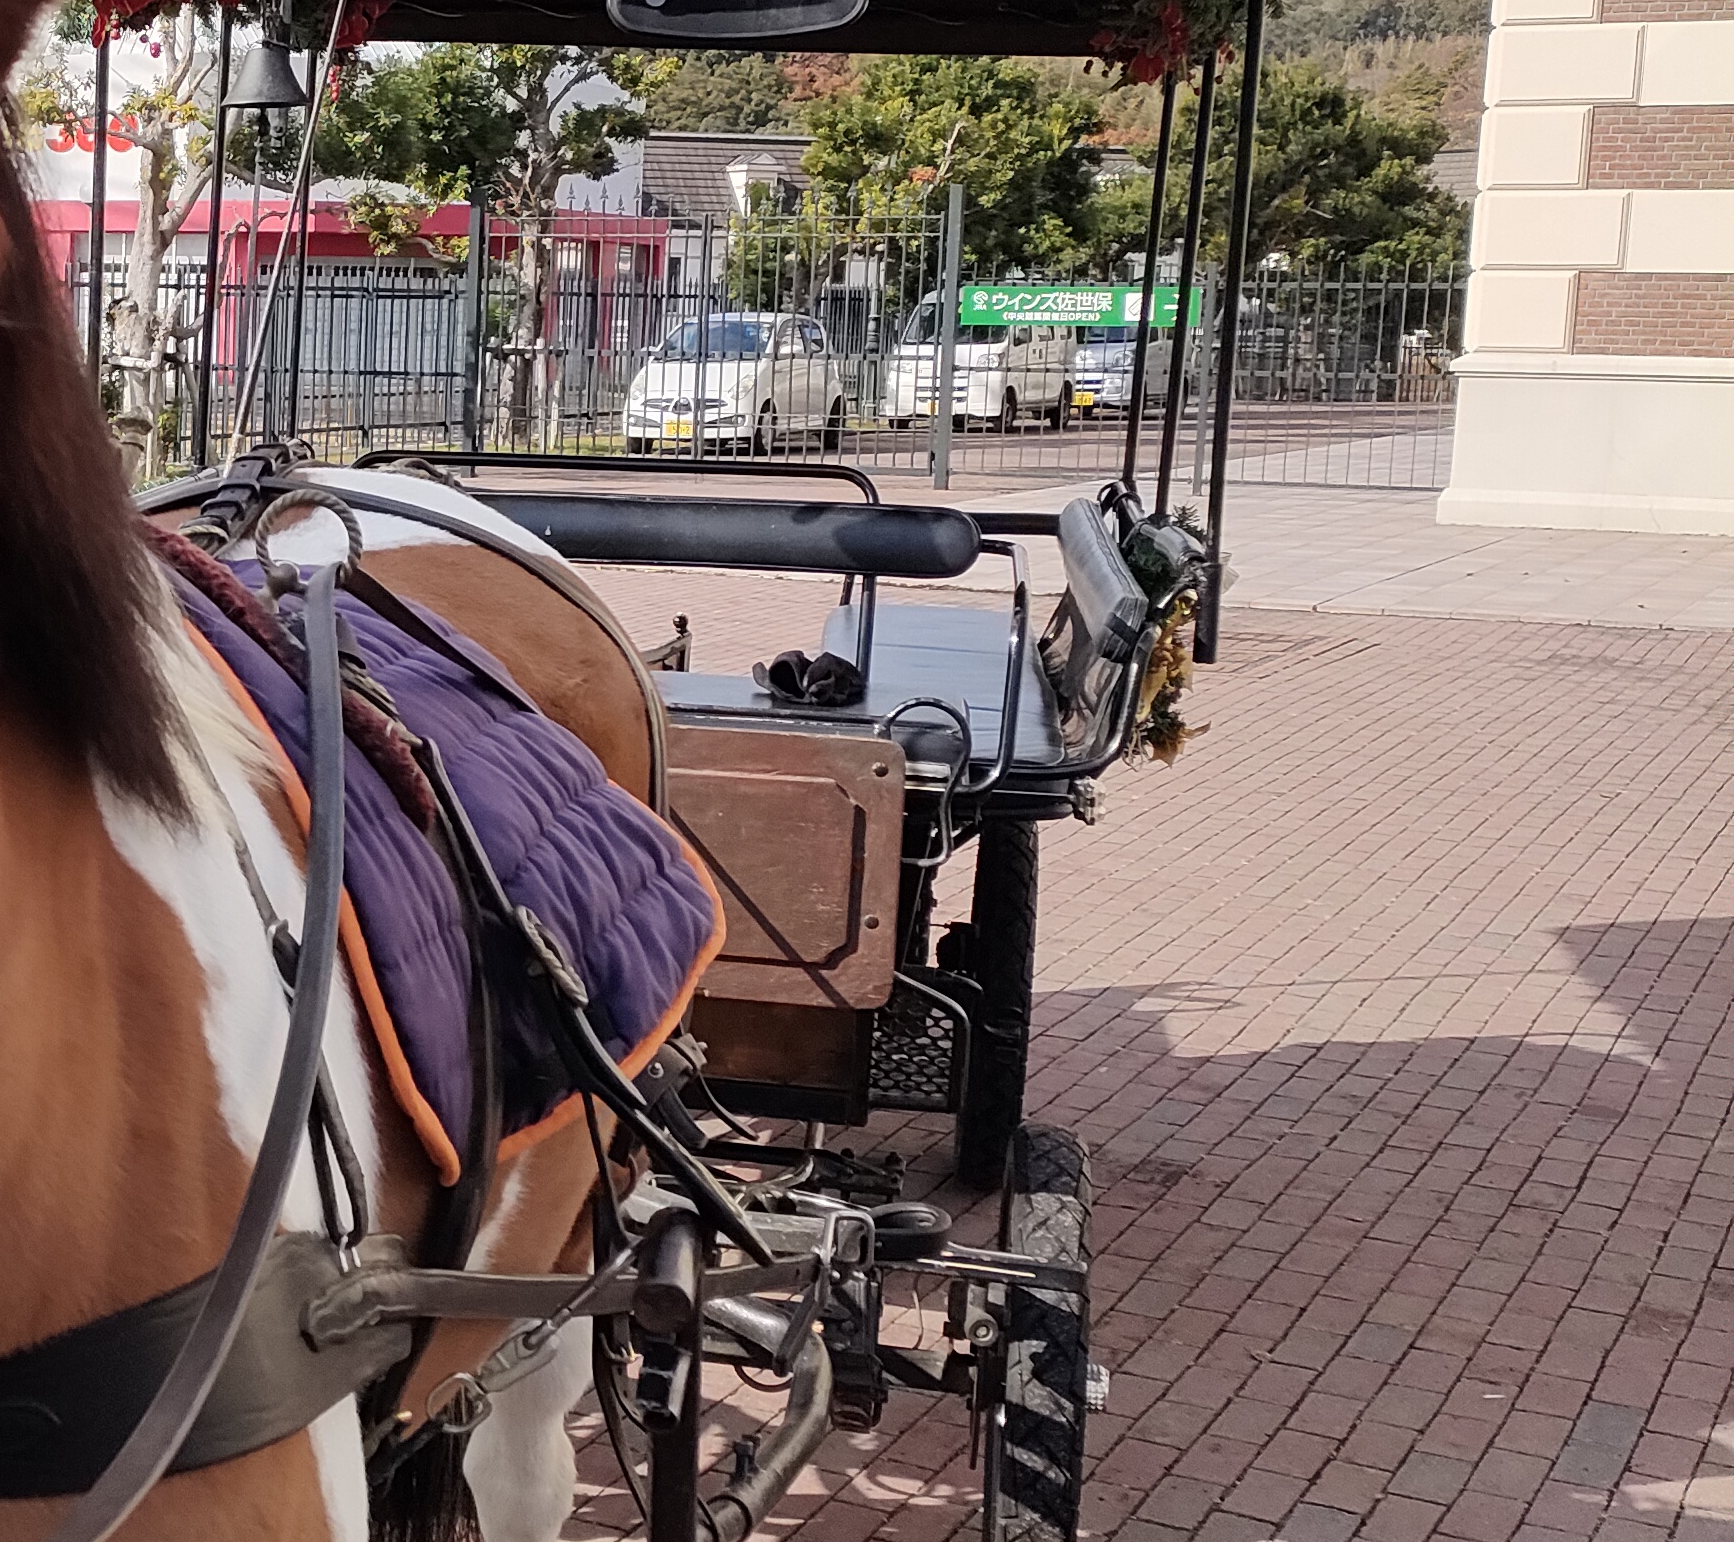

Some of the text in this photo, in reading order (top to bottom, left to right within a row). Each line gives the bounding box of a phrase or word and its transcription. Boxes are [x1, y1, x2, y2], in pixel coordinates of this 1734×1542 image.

[991, 292, 1113, 311] ウインズ佐世保
